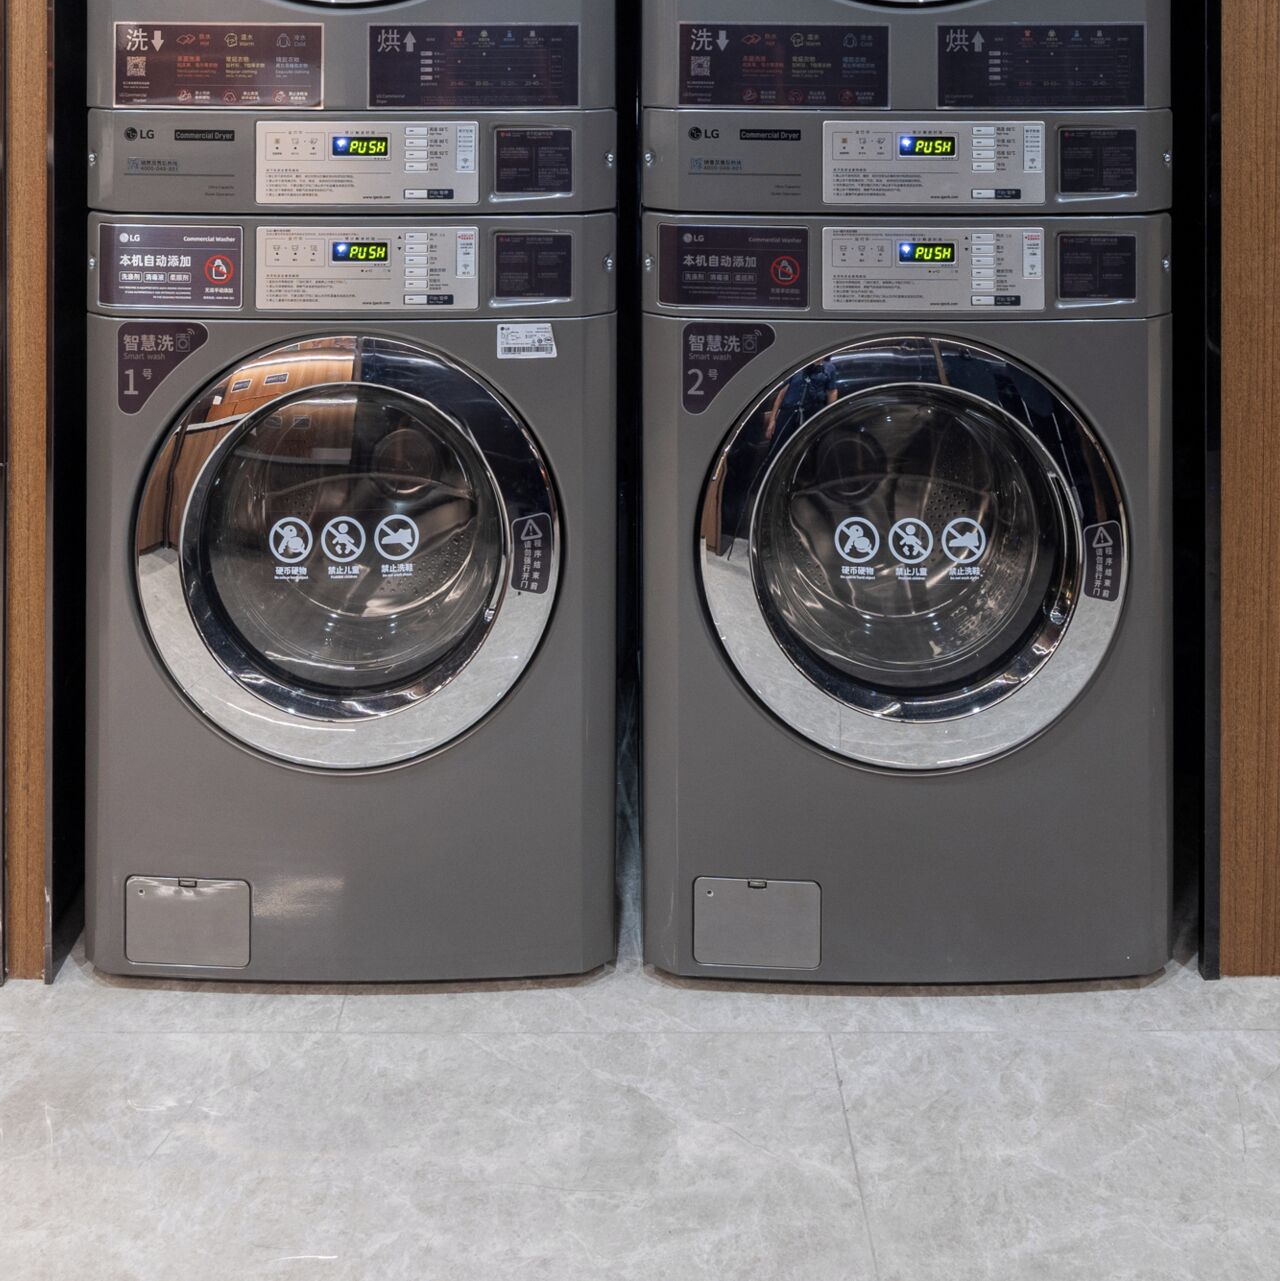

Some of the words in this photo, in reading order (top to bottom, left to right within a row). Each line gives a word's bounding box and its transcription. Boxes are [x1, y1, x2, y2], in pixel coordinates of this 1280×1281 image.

[126, 28, 148, 52] 洗
[377, 29, 401, 53] 烘
[690, 28, 713, 51] 洗
[946, 29, 970, 53] 烘
[140, 129, 155, 140] LG
[175, 130, 214, 140] Commercial
[215, 130, 233, 140] Dryer
[704, 129, 719, 139] LG
[741, 130, 779, 139] Commercial
[780, 130, 800, 140] Dryer
[349, 140, 386, 154] PUSH
[915, 140, 951, 153] PUSH
[349, 246, 386, 259] PUSH
[915, 247, 951, 259] PUSH
[120, 254, 191, 267] 本机自动添加
[683, 255, 757, 268] 本机自动添加
[123, 334, 174, 352] 智慧洗
[688, 334, 740, 352] 智慧洗
[123, 352, 144, 360] Smart
[147, 352, 165, 360] wash
[275, 566, 307, 575] 硬币硬物
[328, 565, 360, 574] 禁止儿童
[381, 563, 413, 573] 禁止洗鞋
[841, 566, 874, 575] 硬币硬物
[895, 567, 928, 576] 禁止儿童
[949, 566, 981, 577] 禁止洗鞋
